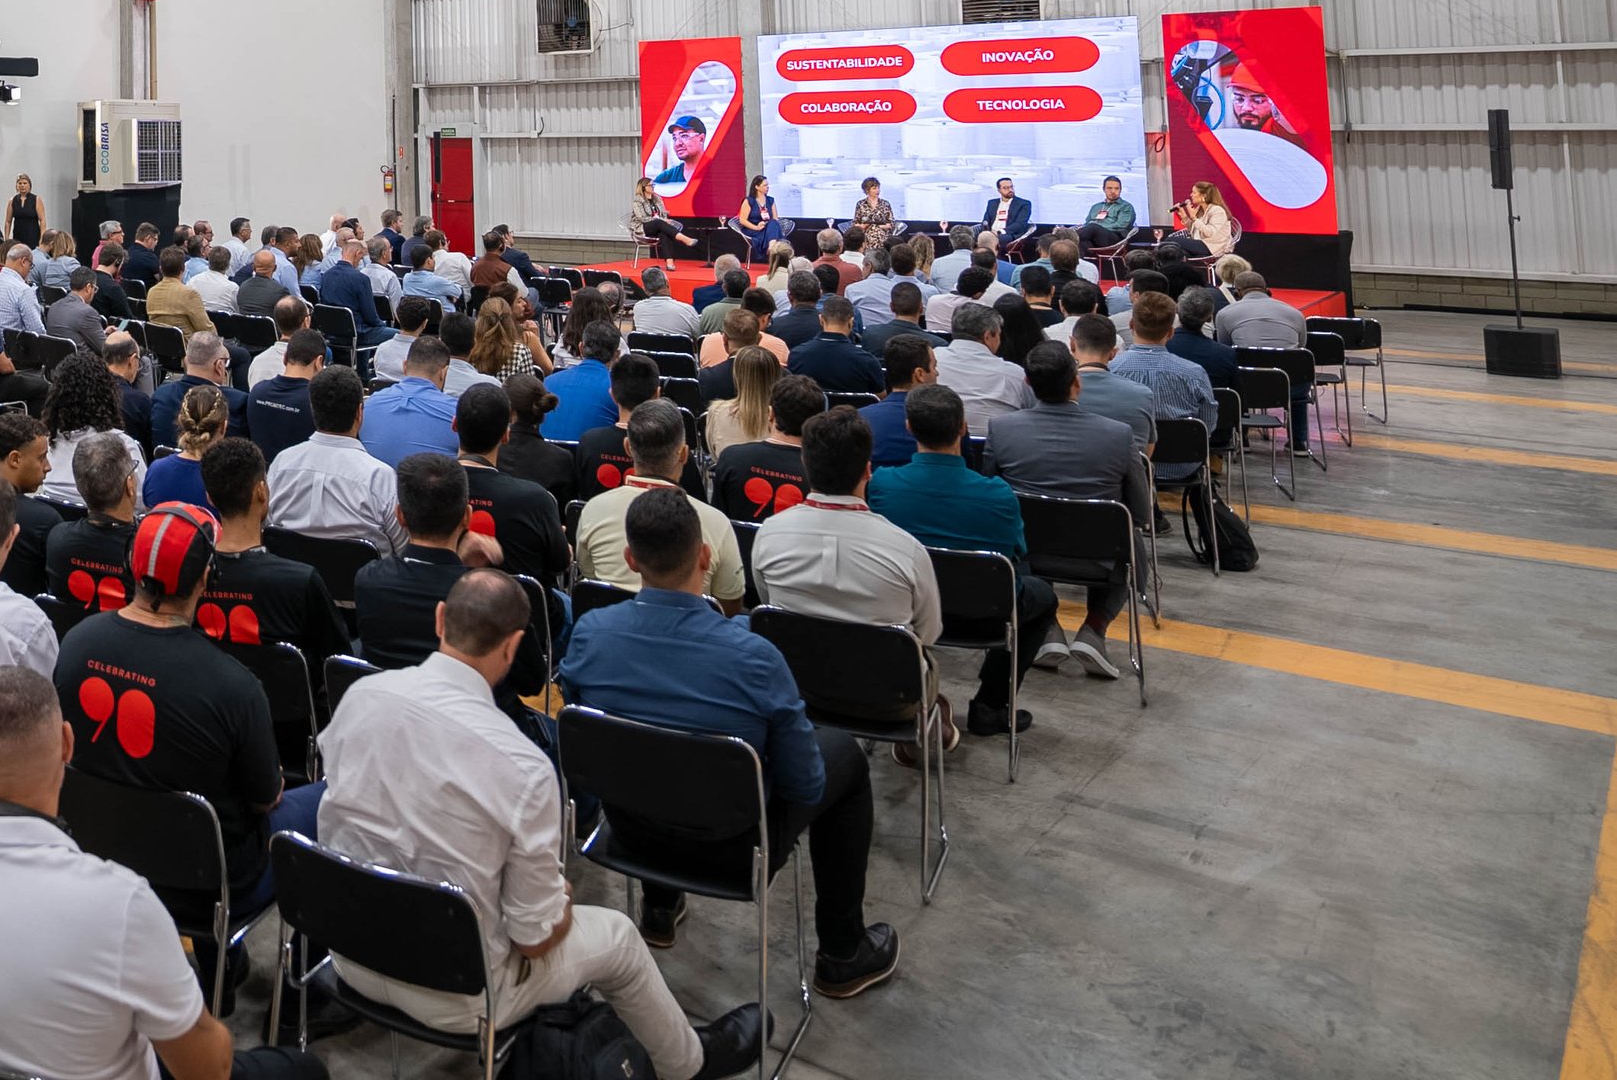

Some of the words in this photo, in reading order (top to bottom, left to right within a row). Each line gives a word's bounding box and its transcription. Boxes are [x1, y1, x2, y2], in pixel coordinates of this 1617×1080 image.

[786, 56, 903, 70] SUSTENTABILIDADE
[981, 48, 1054, 64] INOVAÇÃO
[800, 99, 892, 114] COLABORAÇÃO
[976, 98, 1065, 111] TECNOLOGIA
[750, 465, 803, 482] CELEBRATING
[70, 557, 124, 575] CELEBRATING
[87, 659, 156, 688] CELEBRATING
[78, 676, 156, 759] 90
